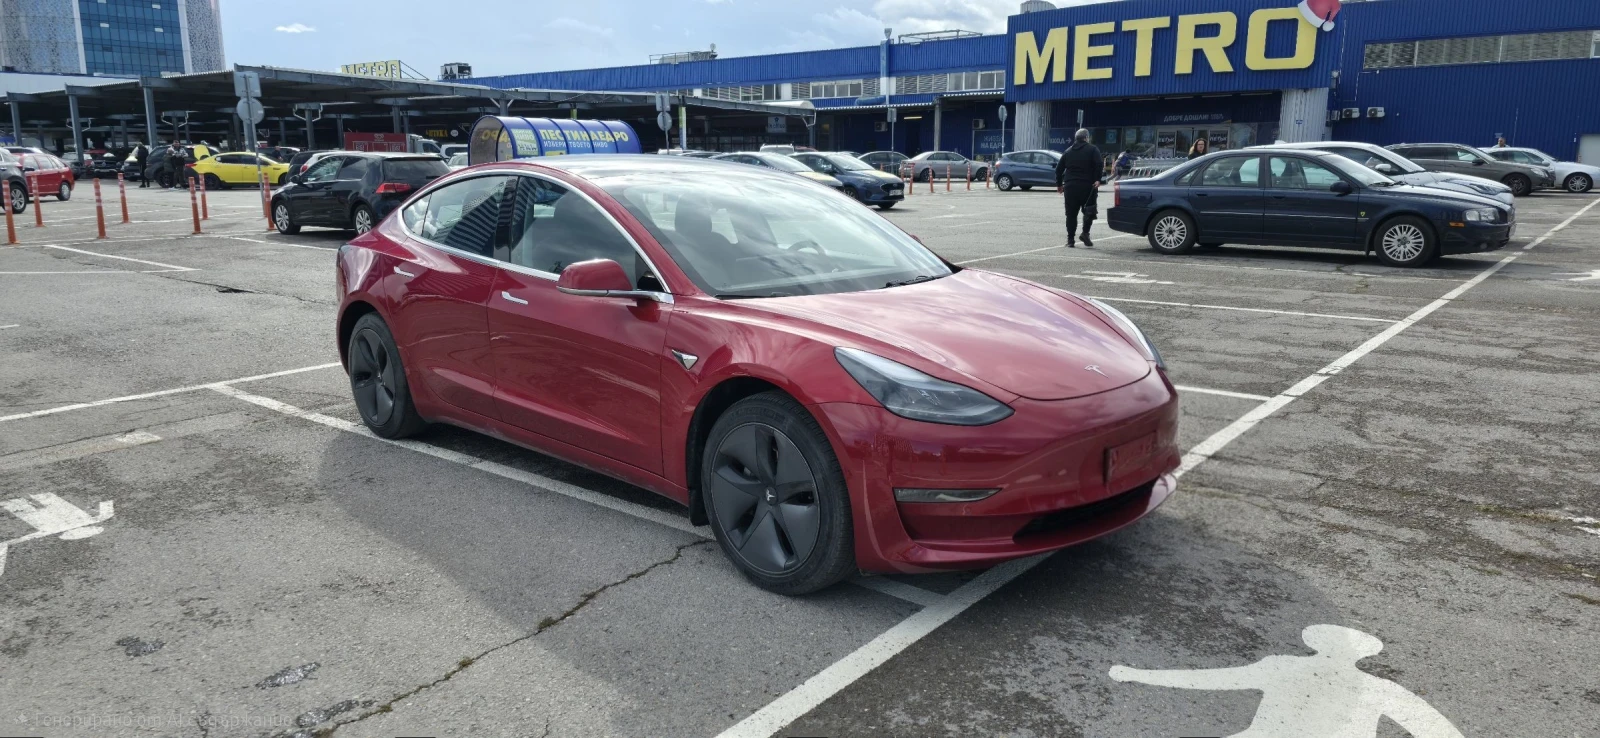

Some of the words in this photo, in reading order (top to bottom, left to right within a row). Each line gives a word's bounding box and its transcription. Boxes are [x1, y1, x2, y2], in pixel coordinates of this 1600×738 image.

[1014, 7, 1318, 86] METRO
[341, 60, 401, 79] METRO
[1163, 115, 1183, 123] ДОБРЕ
